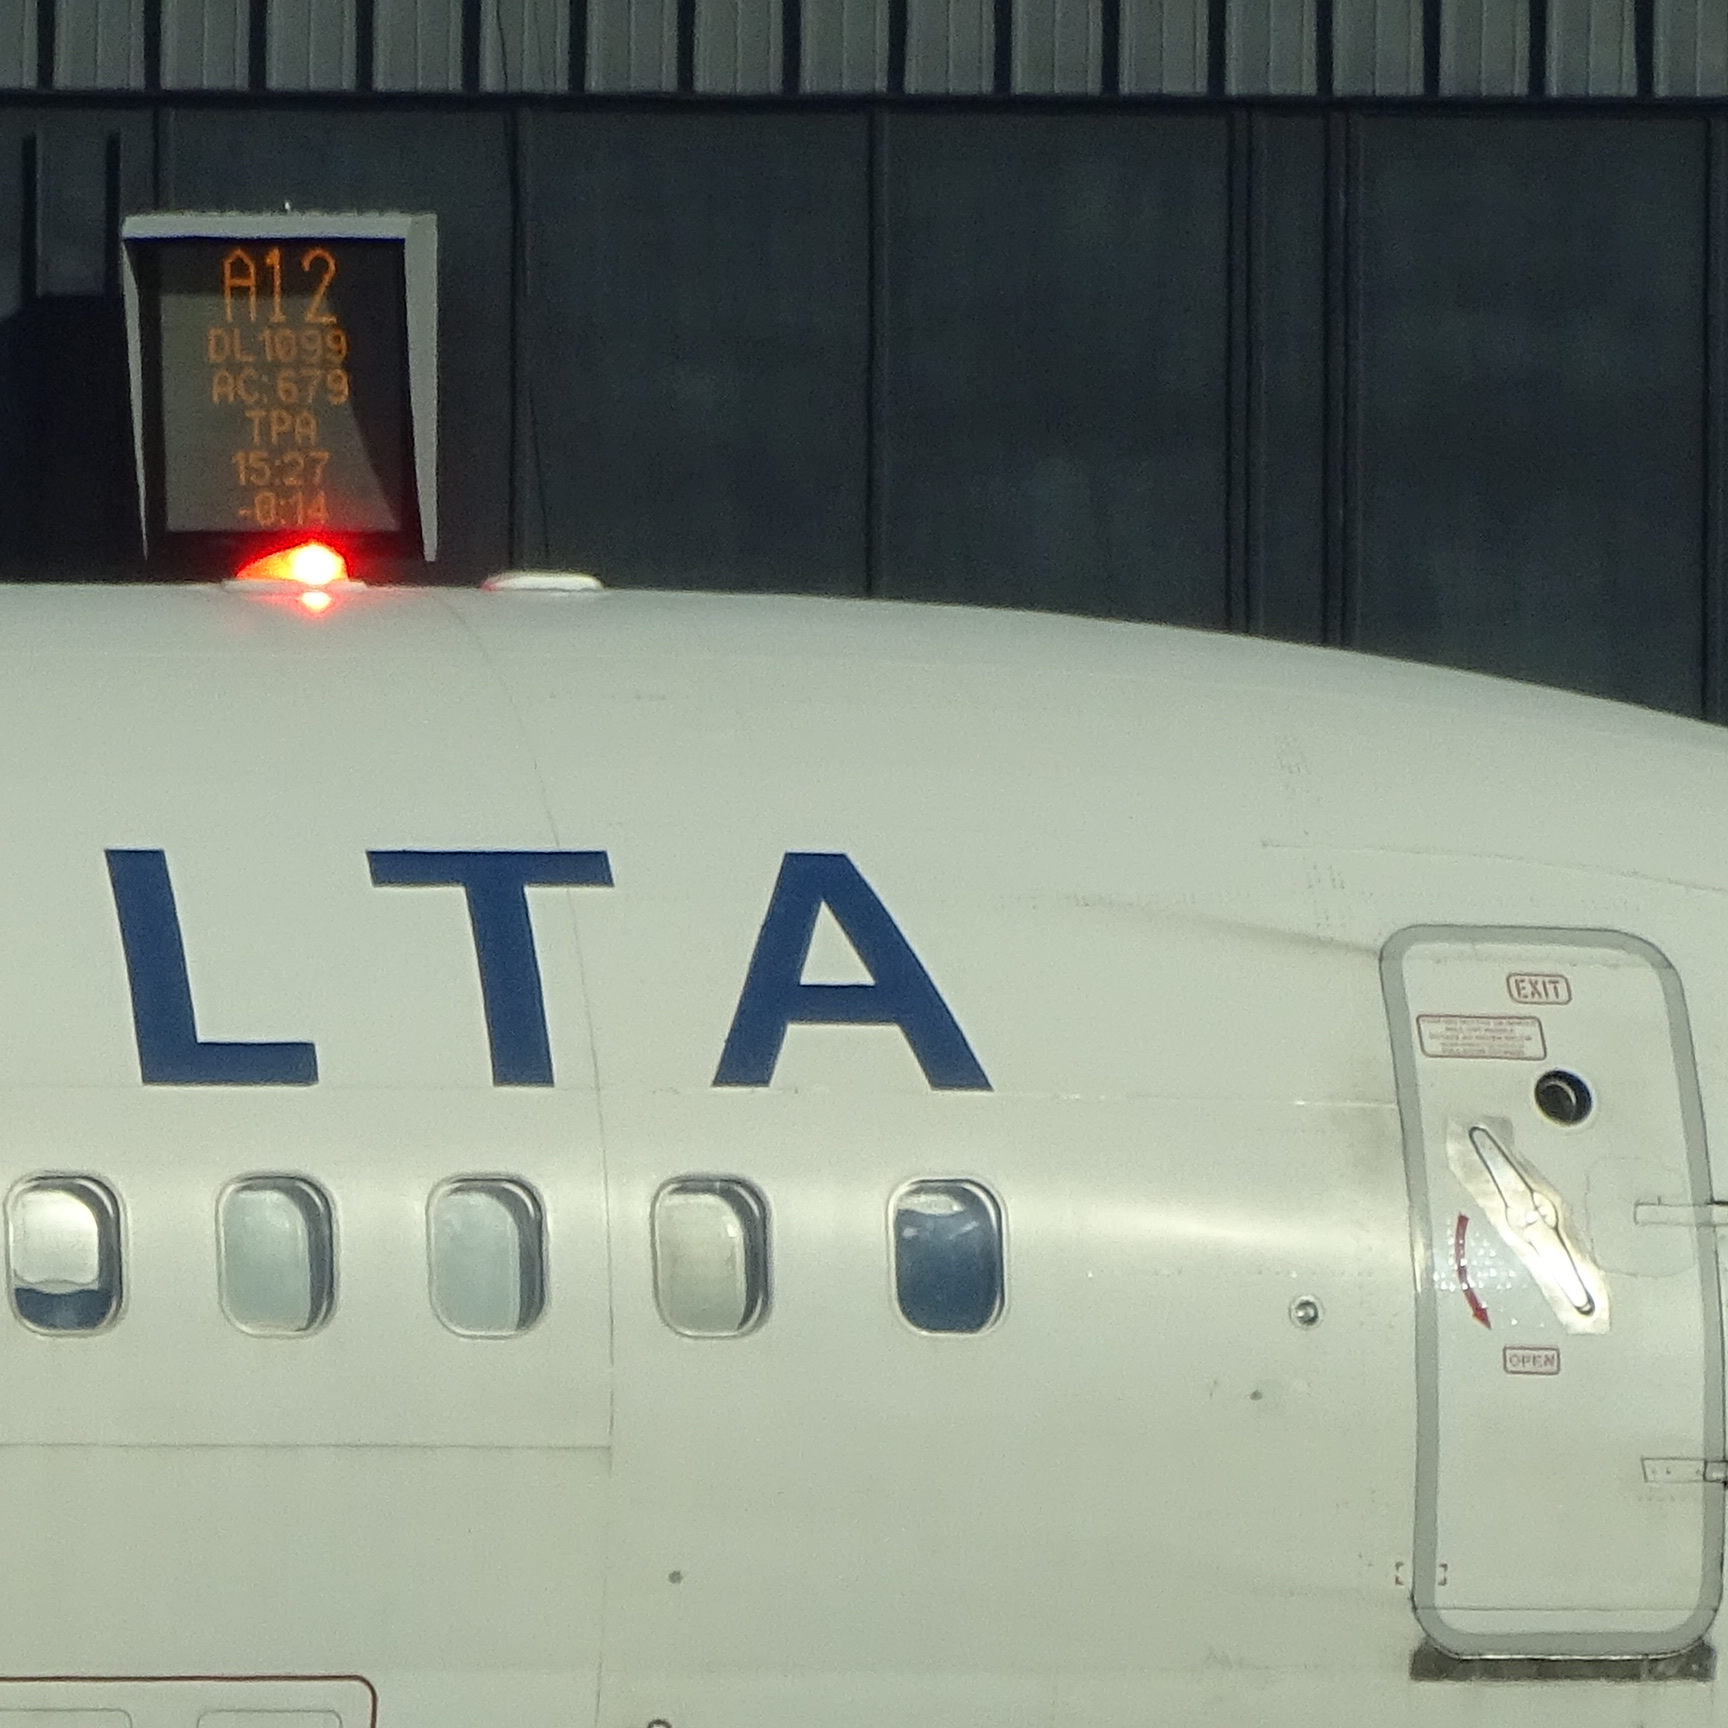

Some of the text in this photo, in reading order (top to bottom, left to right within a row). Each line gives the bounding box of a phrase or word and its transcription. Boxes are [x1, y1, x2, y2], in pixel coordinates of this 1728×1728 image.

[222, 247, 338, 323] A12
[206, 327, 349, 364] DL1099
[245, 409, 318, 446] TPA
[233, 450, 330, 486] 15:27
[1514, 978, 1560, 999] EXIT
[1509, 1353, 1556, 1368] OPEN
